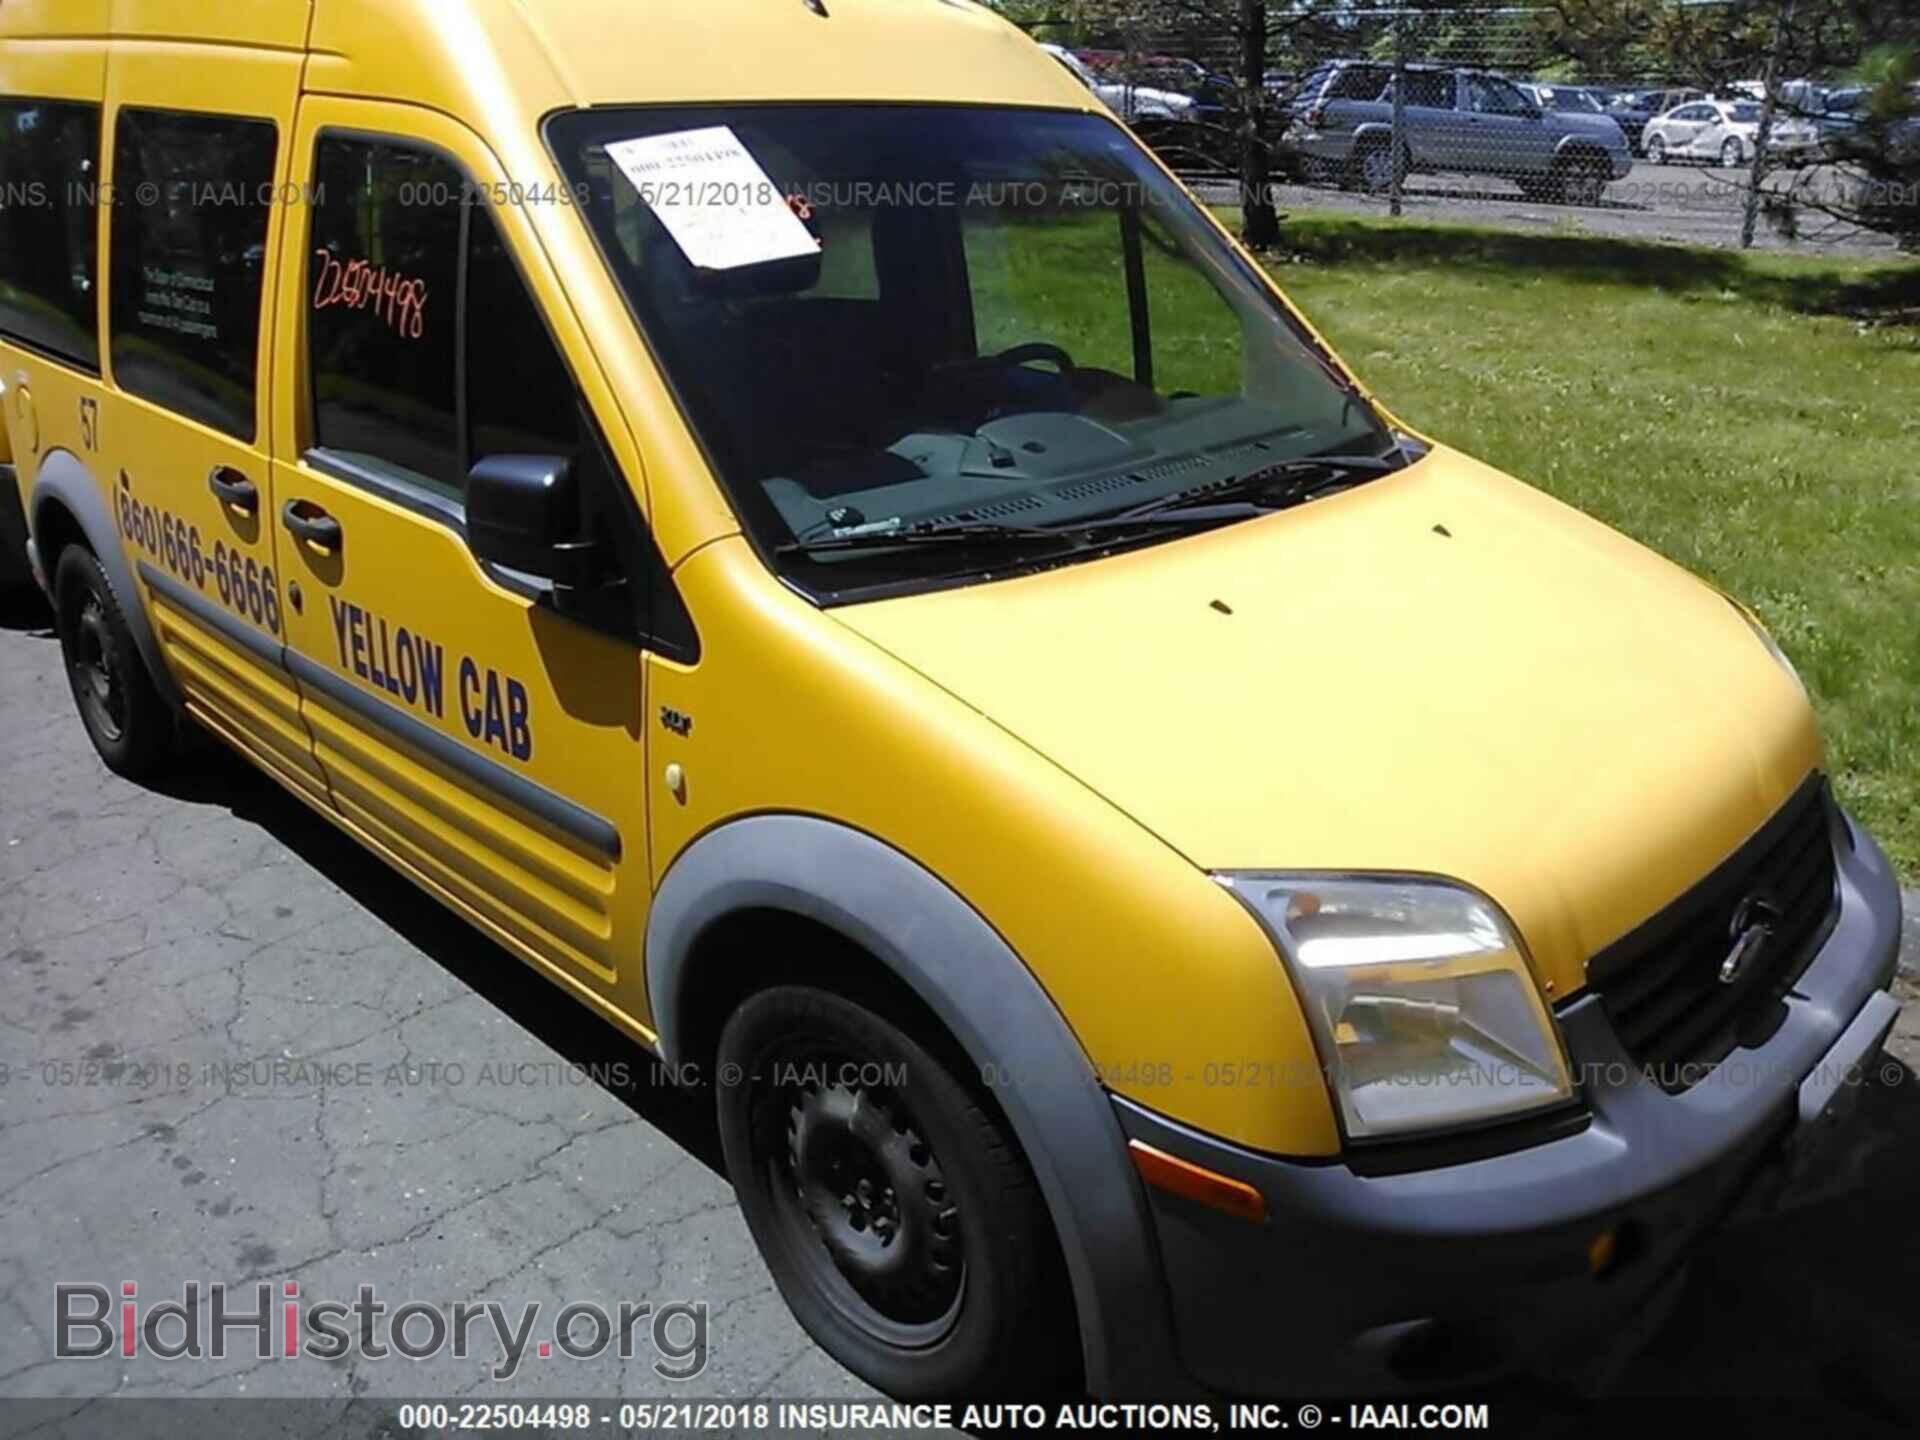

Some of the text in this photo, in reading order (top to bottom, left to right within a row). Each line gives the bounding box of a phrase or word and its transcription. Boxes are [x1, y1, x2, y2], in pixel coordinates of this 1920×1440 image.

[314, 249, 428, 338] 22504498
[80, 396, 98, 452] 57
[112, 482, 280, 635] (860)666-6666
[329, 594, 532, 762] YELLOW CAB
